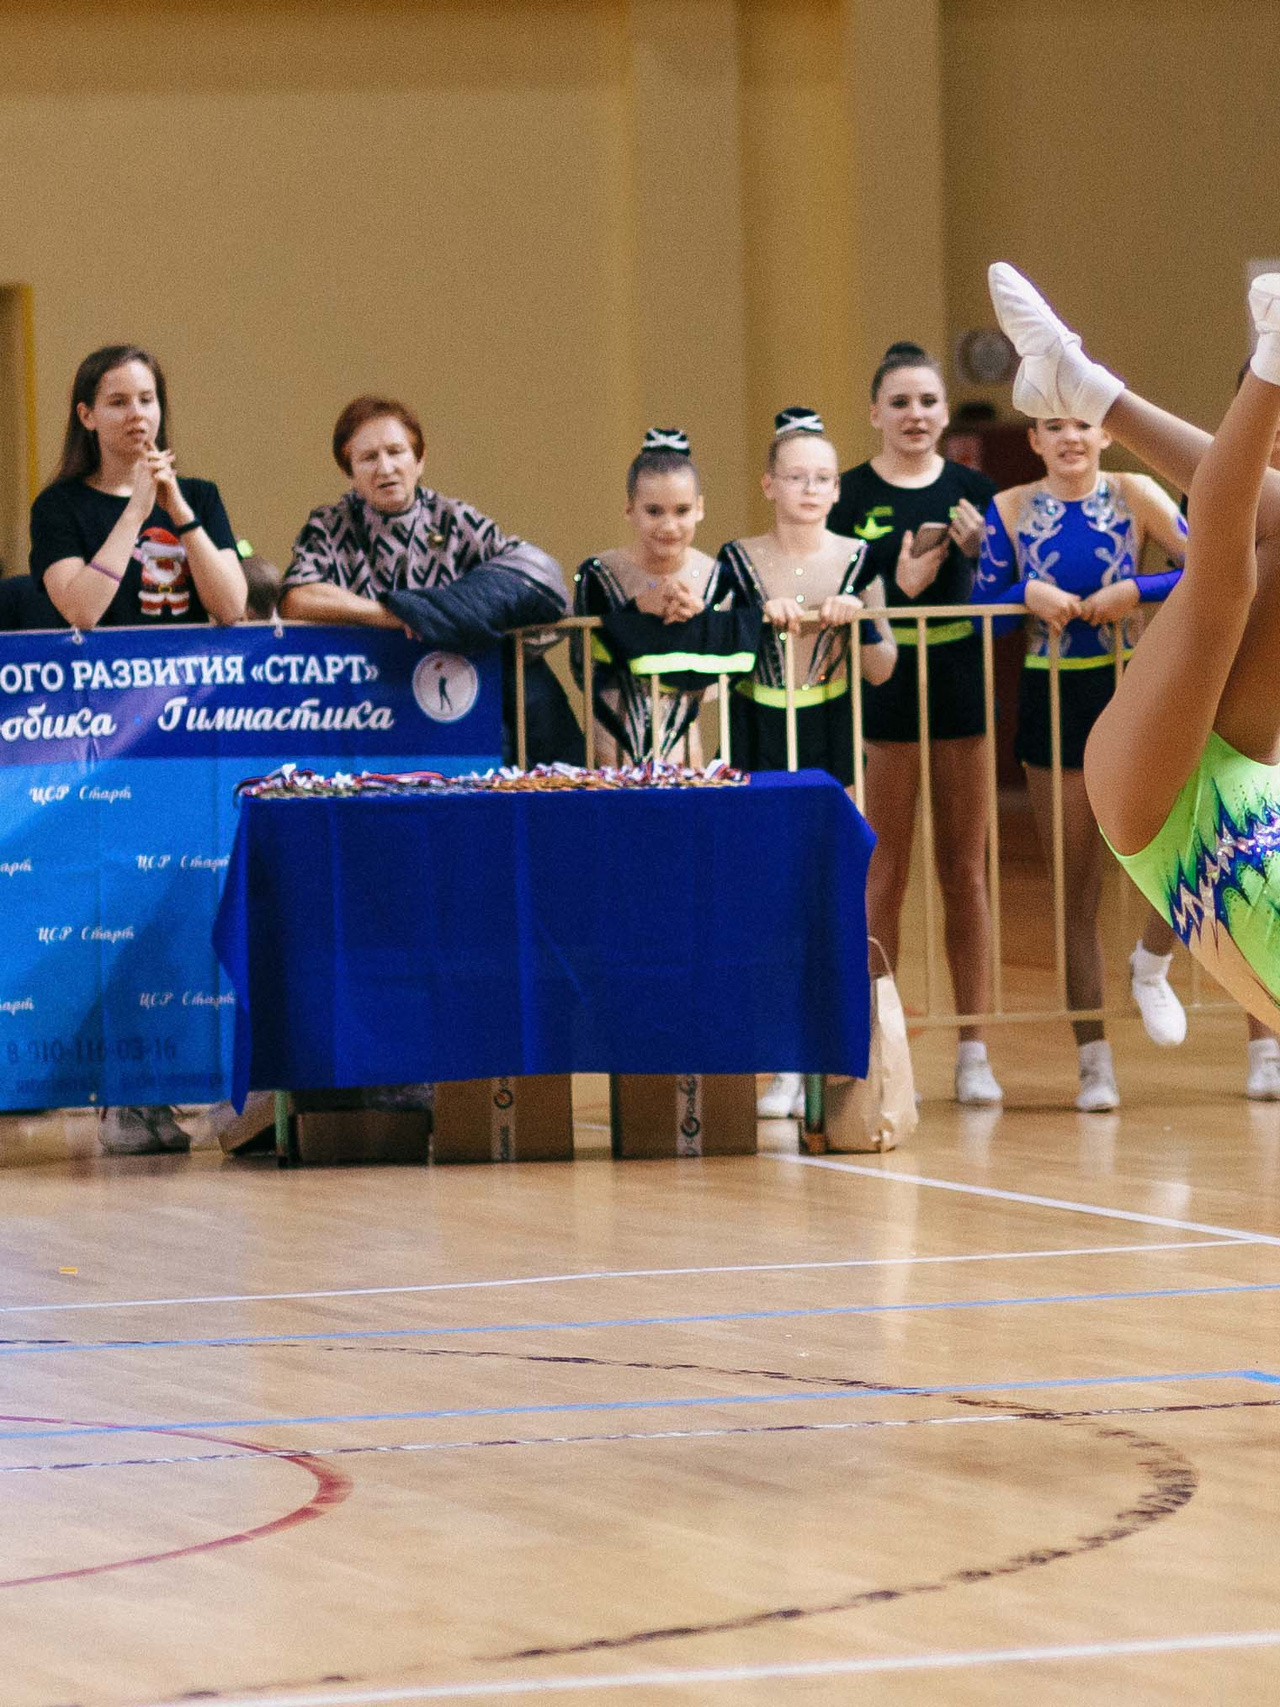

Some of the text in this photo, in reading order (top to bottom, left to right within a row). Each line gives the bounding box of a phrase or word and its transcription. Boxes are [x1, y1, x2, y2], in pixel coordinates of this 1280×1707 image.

[71, 654, 246, 691] РАЗВИТИЯ
[251, 654, 379, 685] «СТАРТ»
[157, 695, 395, 732] Гимнастика
